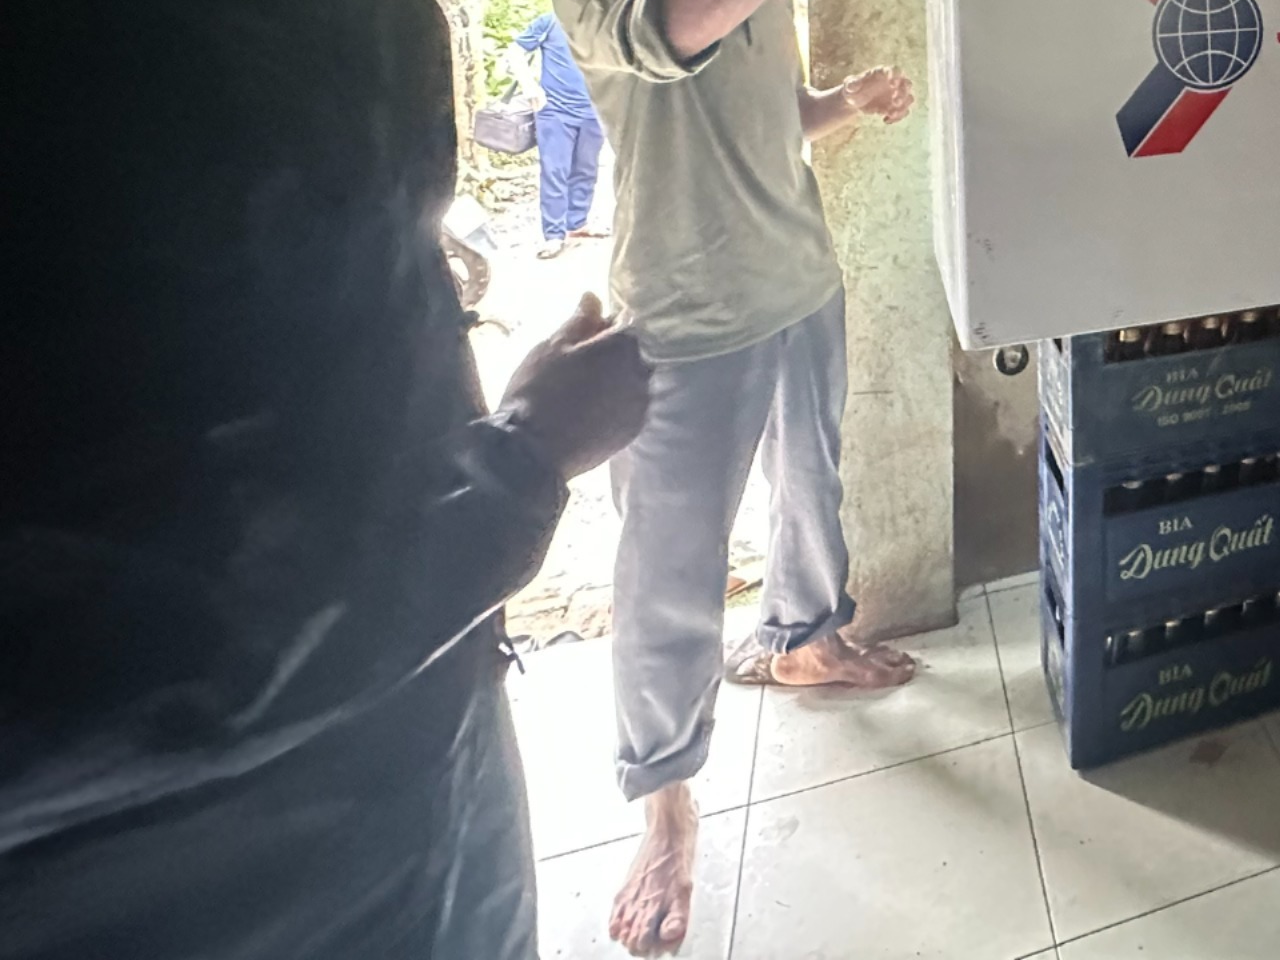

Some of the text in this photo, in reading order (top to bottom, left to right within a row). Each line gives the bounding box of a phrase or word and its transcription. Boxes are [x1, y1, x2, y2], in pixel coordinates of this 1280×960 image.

[1131, 384, 1211, 412] Dung
[1158, 516, 1193, 535] BIA
[1119, 514, 1274, 580] Dung Quất
[1158, 663, 1194, 685] BIA
[1120, 687, 1205, 732] Dung
